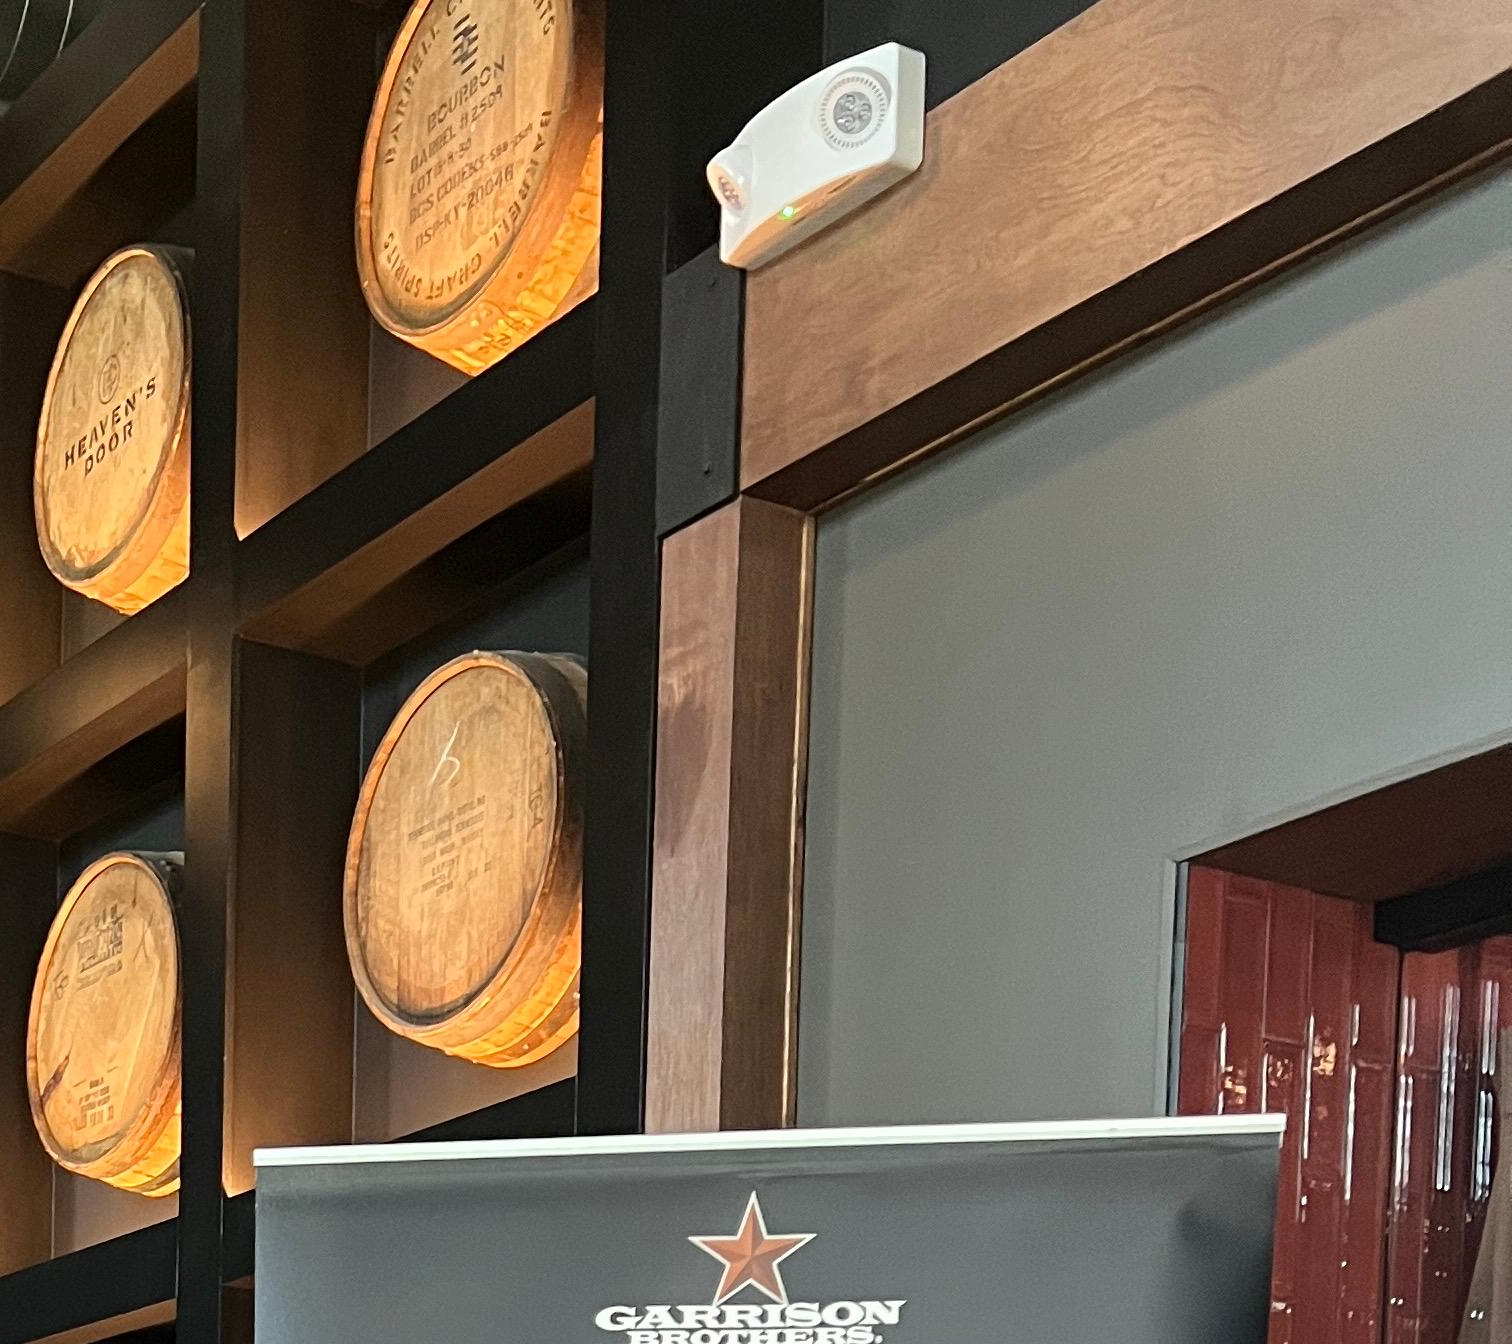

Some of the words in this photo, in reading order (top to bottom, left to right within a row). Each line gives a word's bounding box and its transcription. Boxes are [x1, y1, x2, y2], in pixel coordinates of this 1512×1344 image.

[428, 55, 505, 133] BOURBON
[64, 376, 156, 471] HEAVEN'S
[84, 420, 133, 477] DOOR
[595, 1299, 907, 1331] GARRISON
